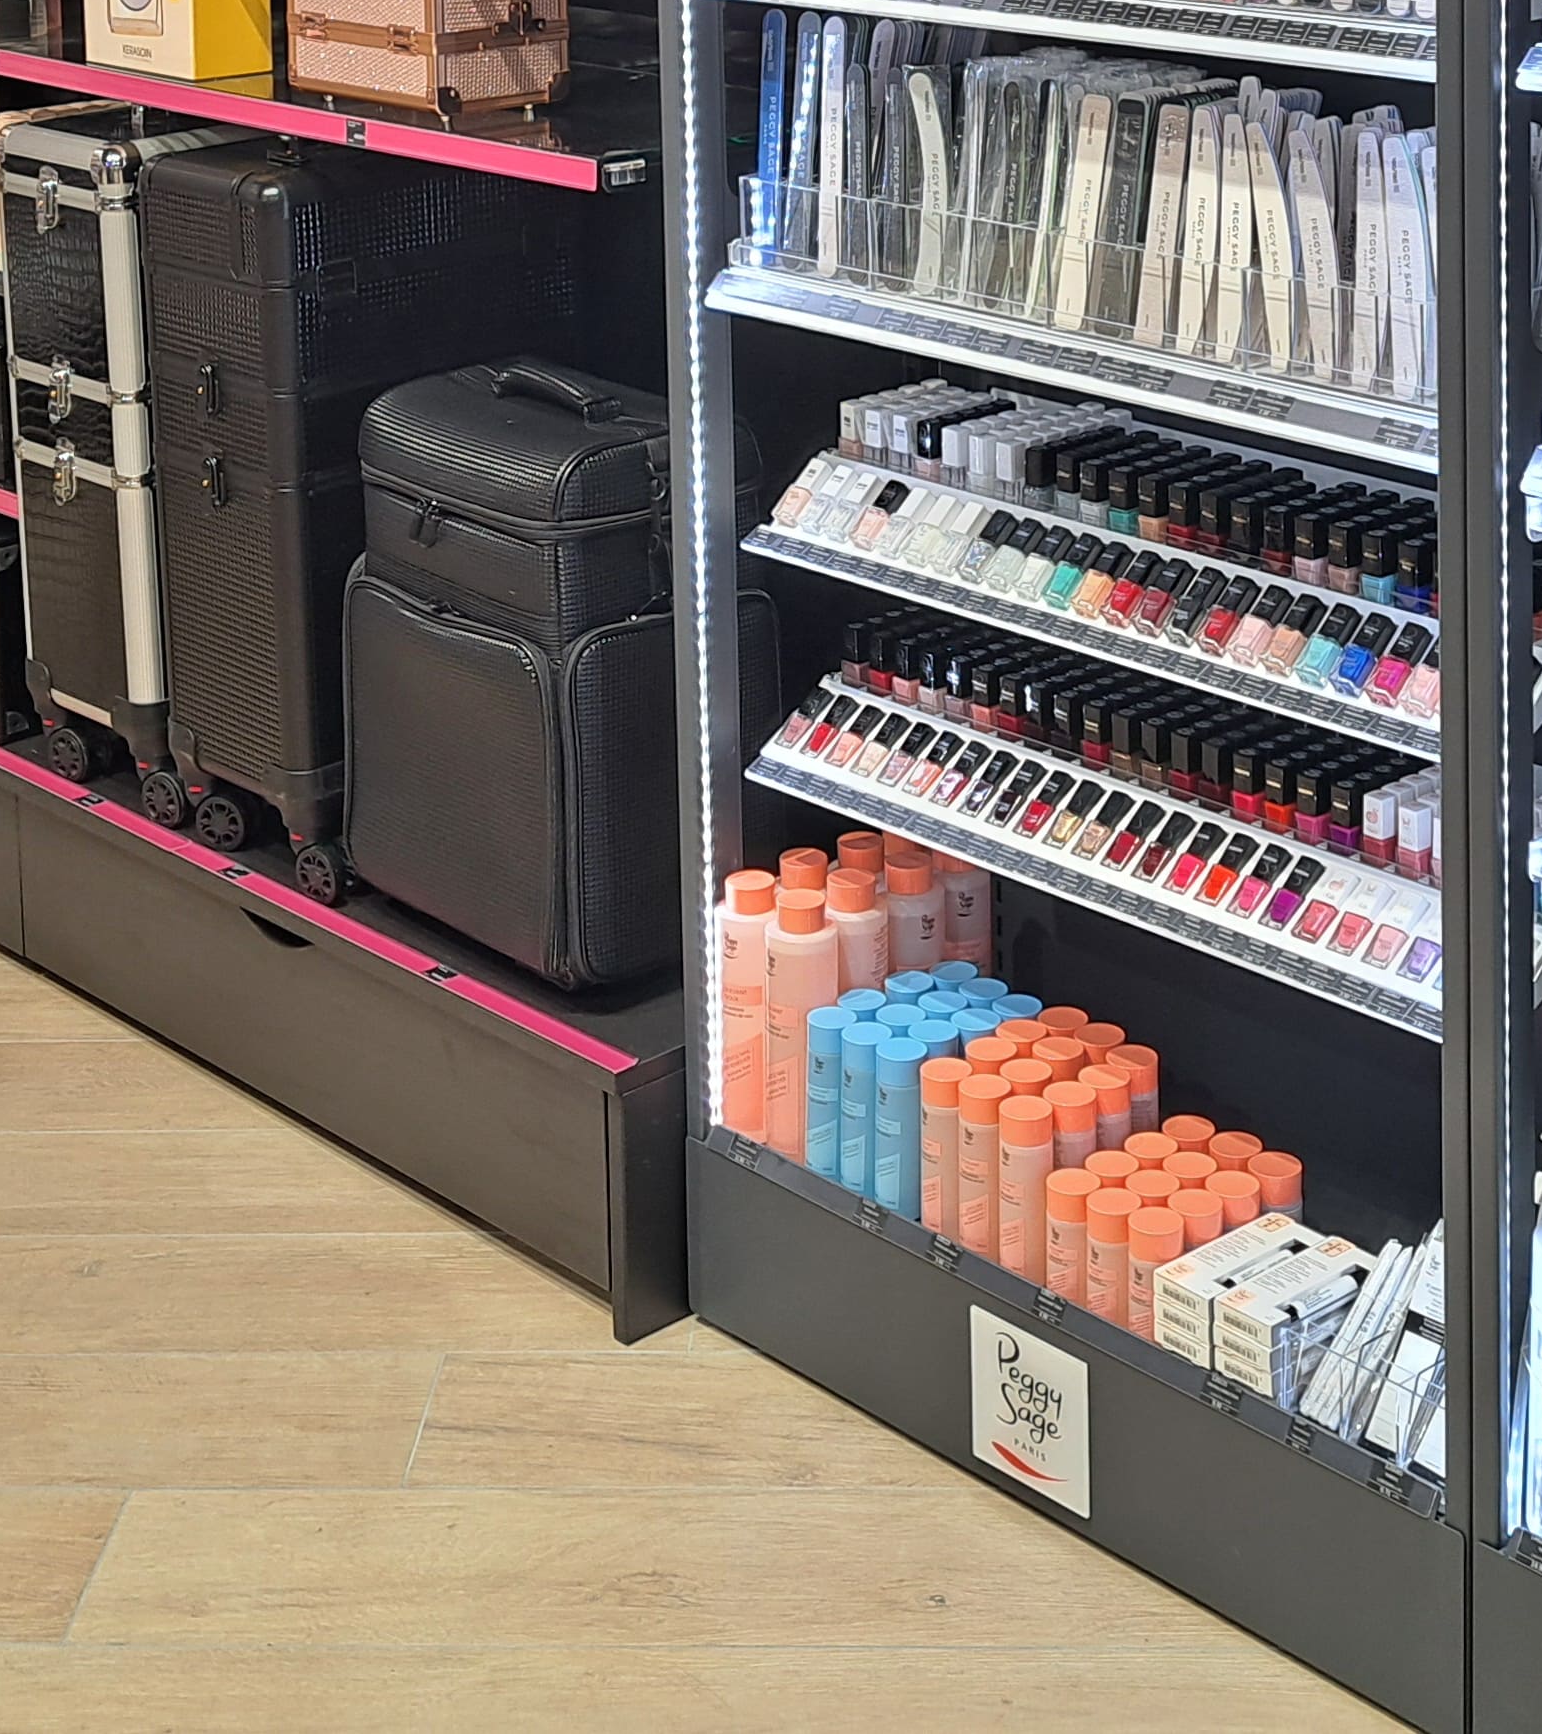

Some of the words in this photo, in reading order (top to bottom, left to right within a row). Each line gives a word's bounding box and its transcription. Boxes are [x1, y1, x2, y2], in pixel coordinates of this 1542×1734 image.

[768, 96, 777, 138] PEGGY
[830, 108, 838, 149] PEGGY
[766, 141, 776, 176] SAGE
[828, 152, 837, 187] SAGE
[930, 153, 940, 187] PEGGY
[1197, 197, 1207, 232] PEGGY
[1231, 202, 1241, 239] PEGGY
[1266, 209, 1277, 247] PEGGY
[1310, 217, 1322, 253] PEGGY
[1314, 255, 1325, 290] SAGE
[997, 1332, 1063, 1419] Peggy
[997, 1383, 1062, 1443] Sage
[1014, 1437, 1047, 1462] PARIS
